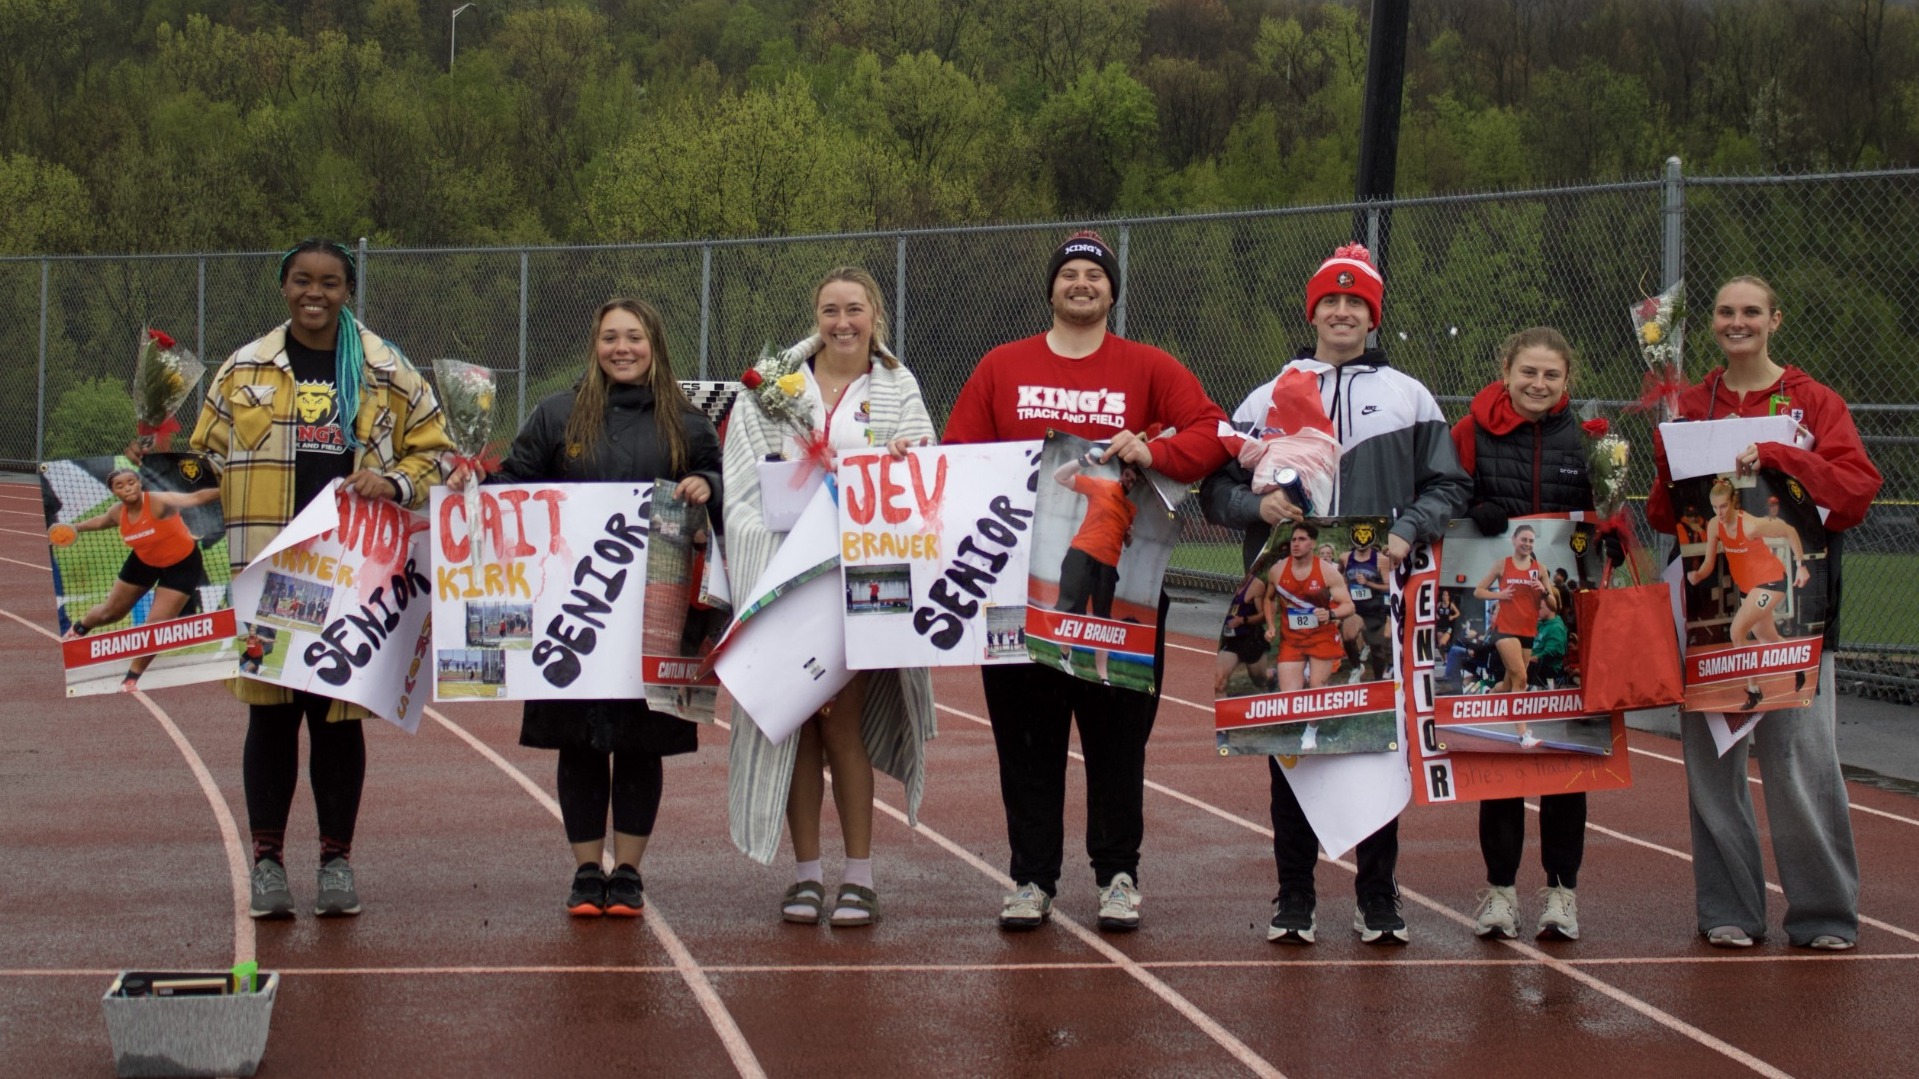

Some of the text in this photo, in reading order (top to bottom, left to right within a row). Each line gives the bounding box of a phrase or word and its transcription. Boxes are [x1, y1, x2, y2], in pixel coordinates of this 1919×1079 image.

[1017, 385, 1126, 414] KING'S
[1017, 407, 1125, 428] TRACK AND FIELD
[298, 424, 345, 445] NG'S
[321, 444, 343, 452] FIELD
[842, 452, 949, 525] JEV
[439, 489, 568, 564] CAIT
[437, 562, 531, 602] KIRK
[913, 495, 1033, 650] SENIOR
[532, 512, 649, 689] SENIOR
[1757, 593, 1769, 608] 3
[303, 558, 431, 687] SENIOR
[1054, 619, 1127, 645] JEV BRAUER
[1297, 615, 1309, 626] 82
[91, 618, 213, 658] BRANDY VARNER
[1698, 645, 1811, 677] SAMANTHA ADAMS
[1245, 688, 1368, 719] JOHN GILLESPIE
[1453, 694, 1583, 719] CECILIA CHIPRIAN
